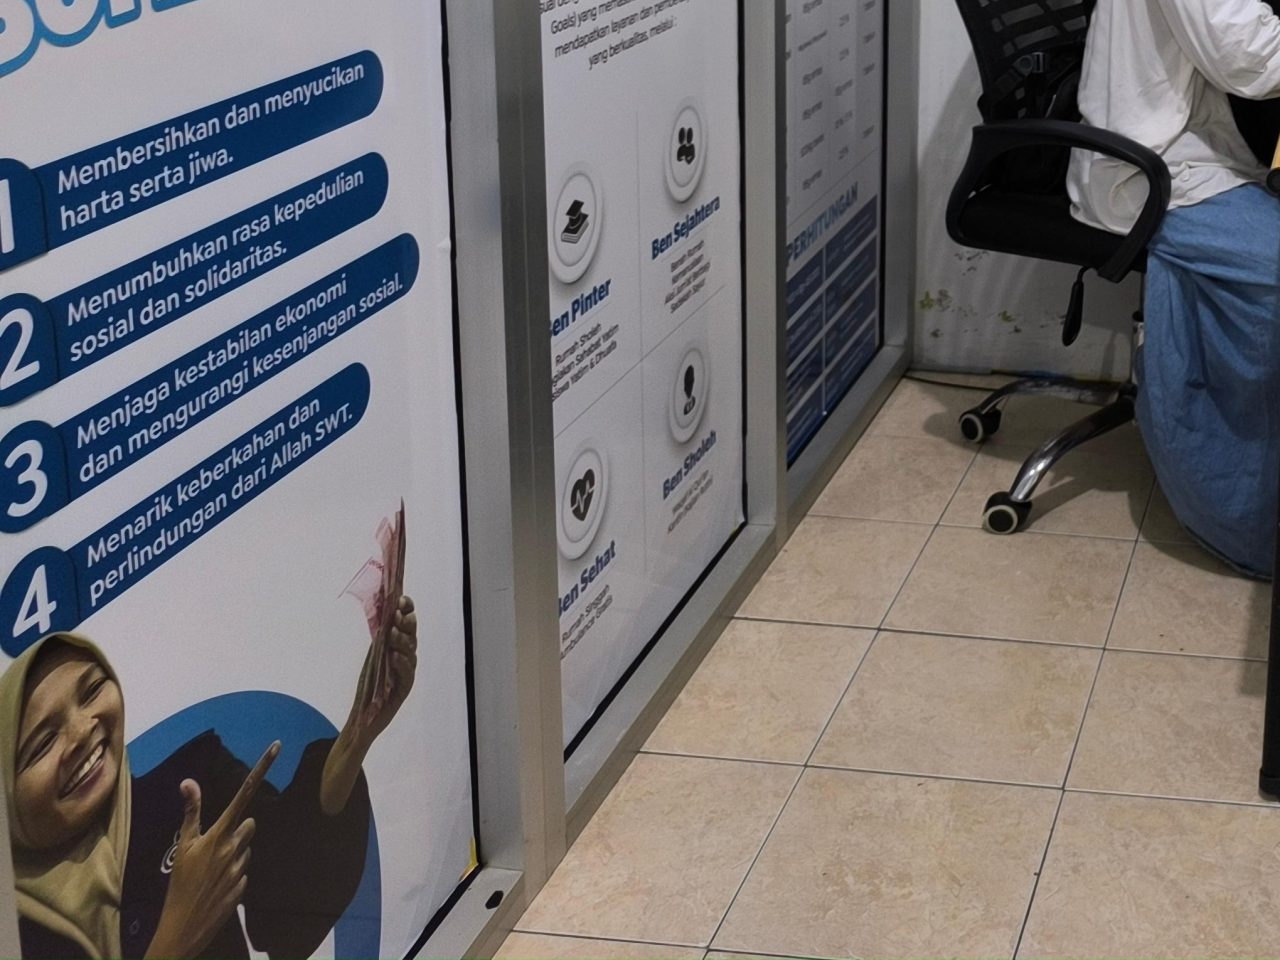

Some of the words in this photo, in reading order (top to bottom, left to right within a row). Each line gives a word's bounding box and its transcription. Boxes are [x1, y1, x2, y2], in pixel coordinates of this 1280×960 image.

[57, 117, 220, 195] Membersihkan
[224, 102, 260, 131] dan
[264, 61, 365, 114] menyucikan
[59, 186, 125, 232] harta
[129, 169, 185, 203] serta
[187, 148, 234, 185] jiwa.
[652, 231, 673, 260] Ben
[673, 196, 720, 242] Sejahtera
[67, 232, 228, 327] Menumbuhkan
[231, 216, 270, 245] rasa
[274, 168, 364, 225] kepedulian
[70, 319, 134, 362] sosial
[139, 289, 180, 327] dan
[184, 242, 288, 303] solidaritas.
[549, 310, 569, 337] en
[571, 279, 611, 322] Pinter
[0, 307, 40, 390] 2
[76, 383, 170, 449] Menjaga
[174, 325, 272, 391] kestabilan
[275, 273, 348, 332] ekonomi
[79, 444, 123, 482] dan
[128, 368, 249, 454] mengurangi
[253, 307, 357, 382] kesenjangan
[360, 271, 403, 313] sosial.
[4, 440, 48, 518] 3
[87, 498, 173, 568] Menarik
[177, 430, 285, 503] keberkahan
[288, 397, 320, 430] dan
[89, 492, 227, 606] perlindungan
[231, 467, 266, 501] dari
[270, 432, 311, 473] Allah
[315, 403, 353, 442] SWT.
[663, 467, 682, 500] Ben
[12, 564, 57, 638] 4
[581, 540, 616, 593] Sehat
